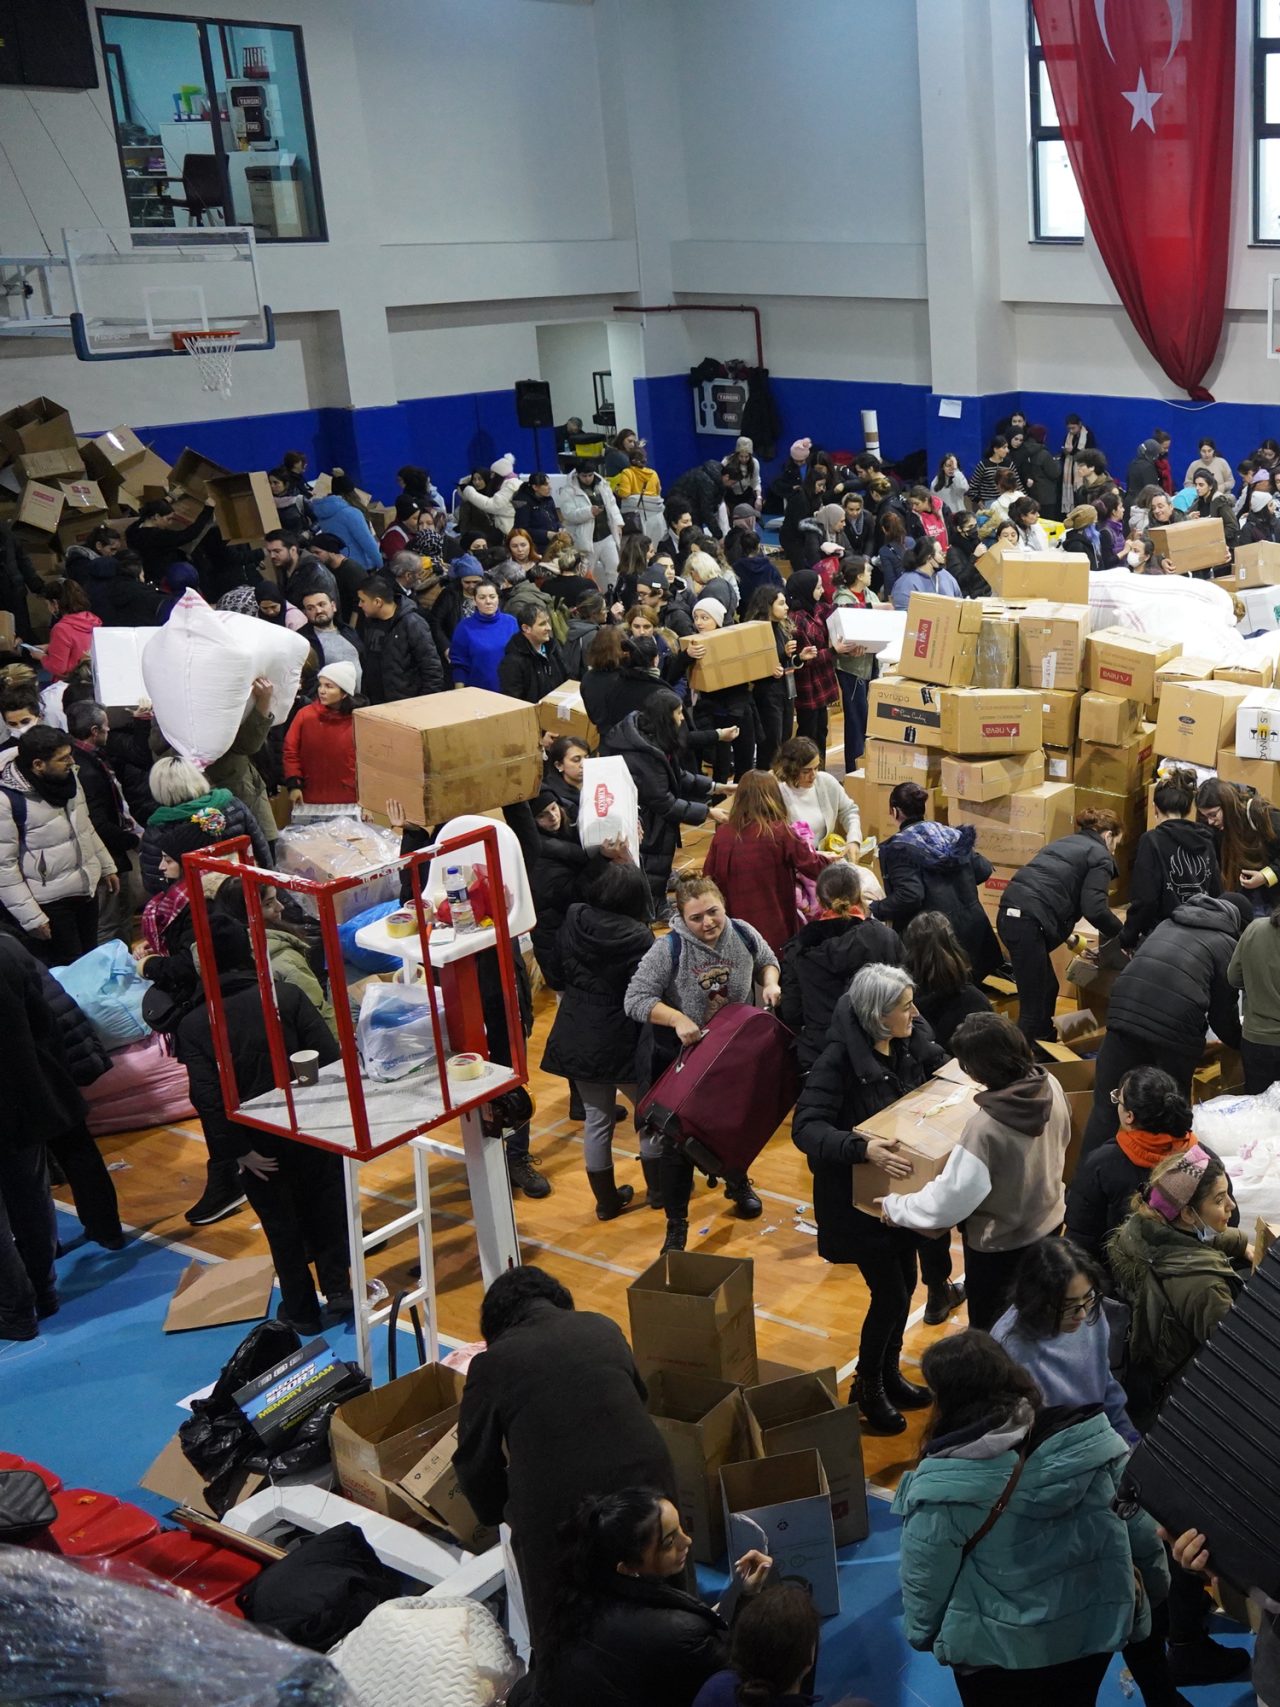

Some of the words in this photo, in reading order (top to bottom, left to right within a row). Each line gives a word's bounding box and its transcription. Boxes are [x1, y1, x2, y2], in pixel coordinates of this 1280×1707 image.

[916, 622, 930, 645] neva
[1102, 670, 1119, 680] neva
[878, 691, 910, 703] avrupa
[985, 727, 1005, 735] neva
[256, 1385, 303, 1419] MEMORY
[304, 1365, 335, 1387] FOAM
[265, 1366, 317, 1404] SPORT
